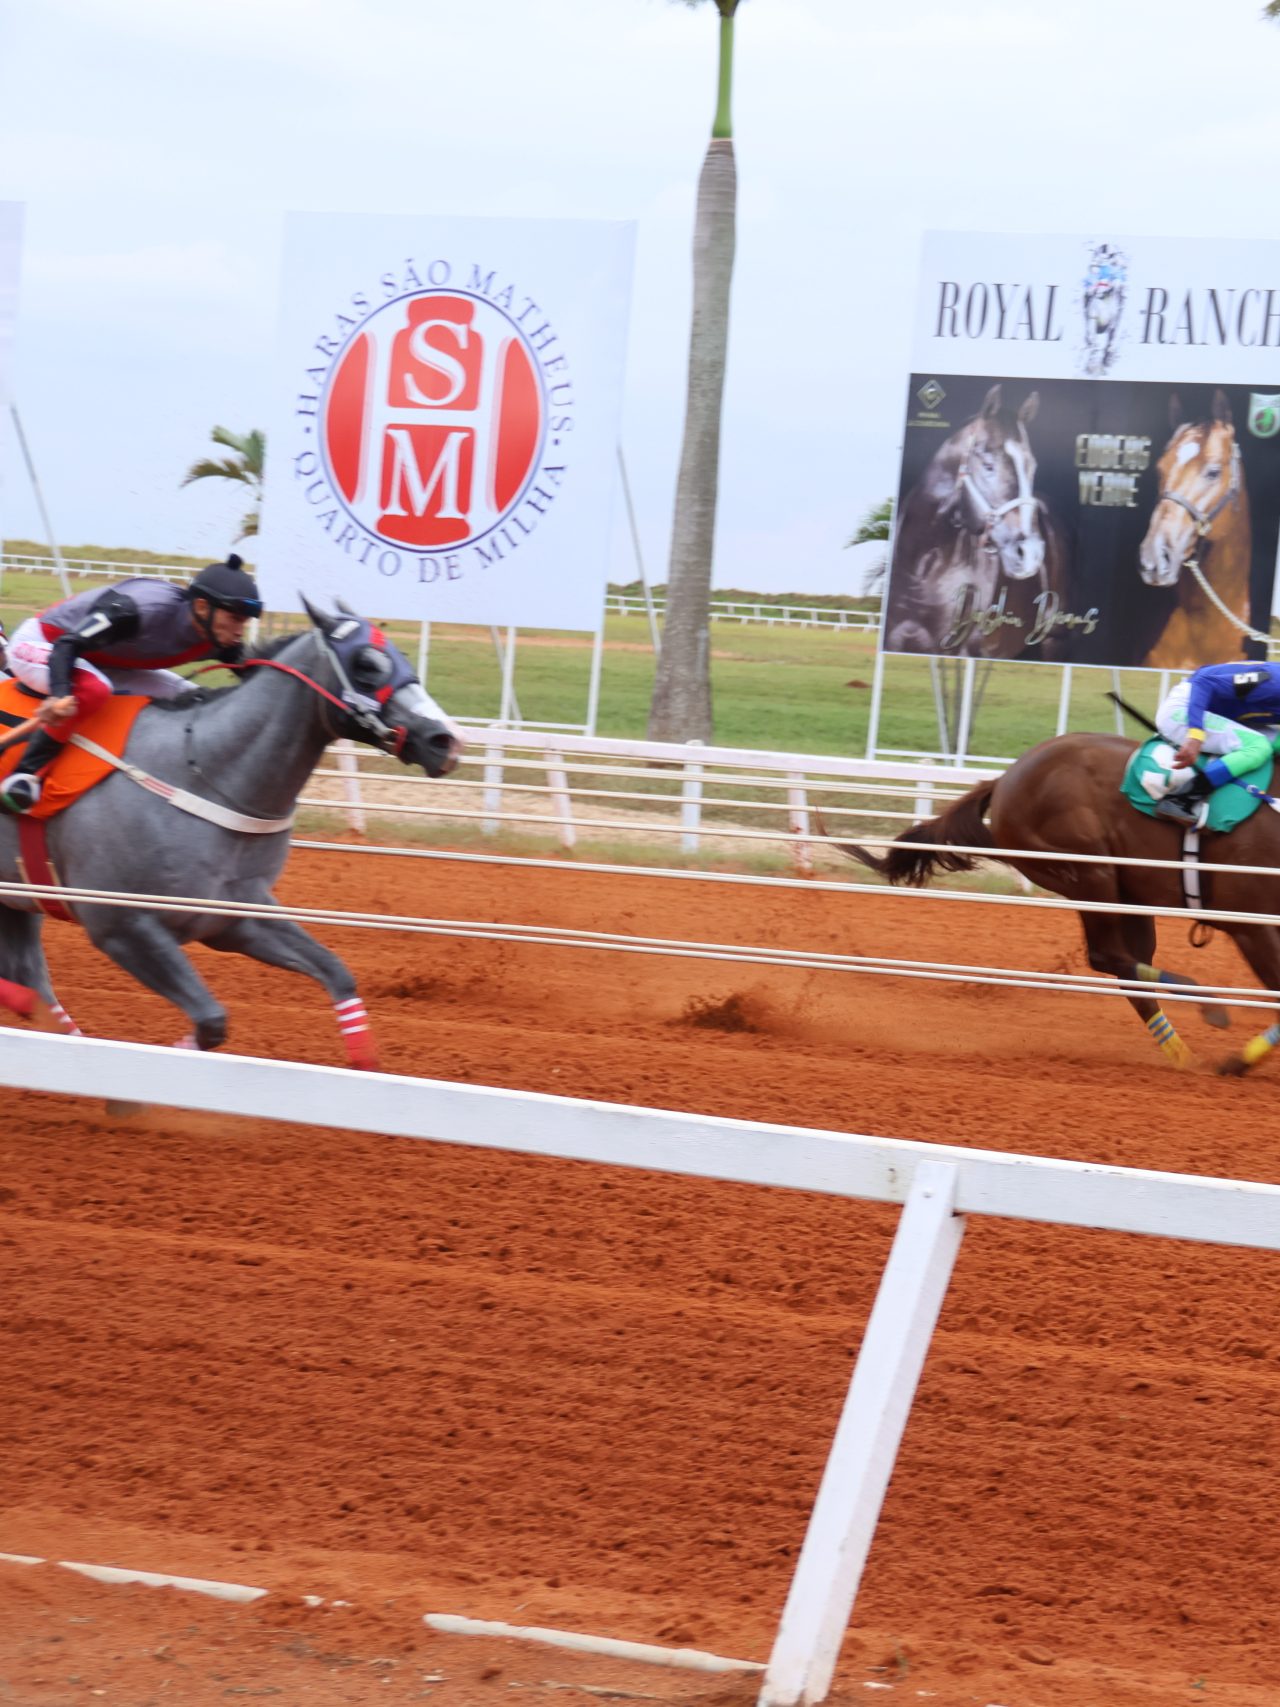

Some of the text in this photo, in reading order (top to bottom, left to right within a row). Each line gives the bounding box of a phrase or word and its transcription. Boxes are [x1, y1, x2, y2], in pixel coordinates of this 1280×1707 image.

[296, 257, 575, 433] HARAS SÃO MATHEUS
[933, 281, 1064, 342] ROYAL
[291, 451, 568, 584] QUARTO DE MILHA
